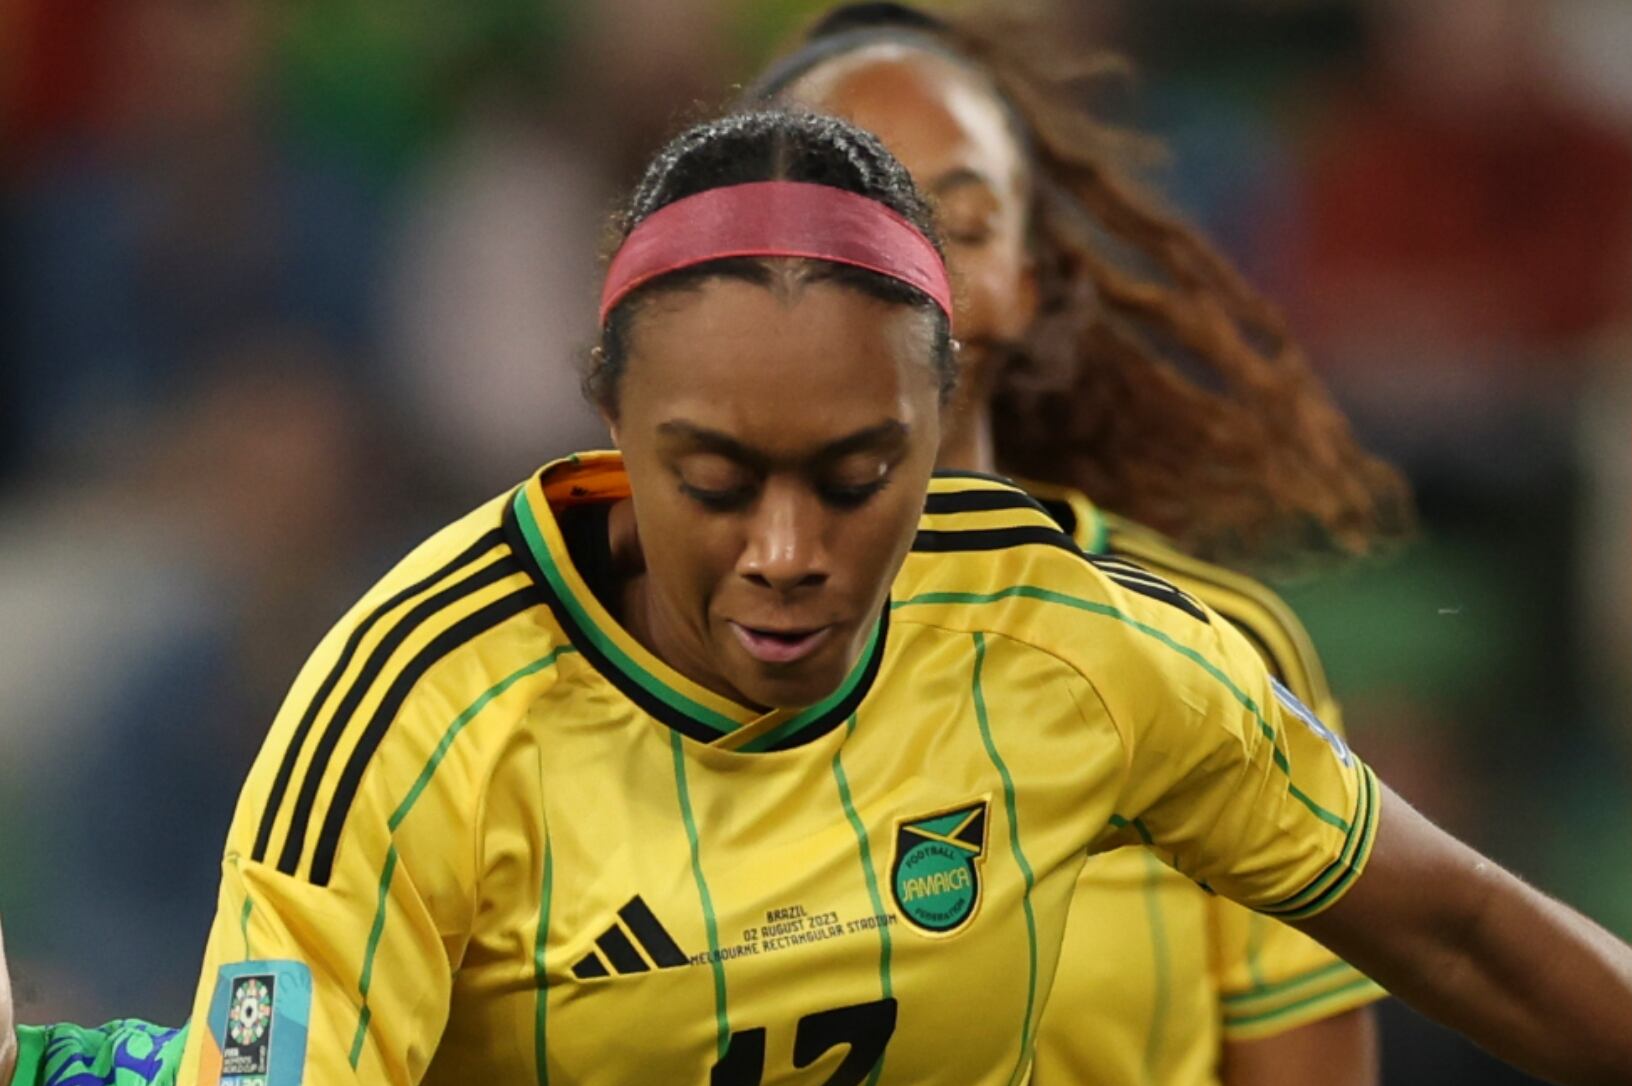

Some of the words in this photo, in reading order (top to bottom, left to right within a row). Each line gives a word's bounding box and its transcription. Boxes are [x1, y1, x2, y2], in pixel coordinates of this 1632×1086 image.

[905, 846, 956, 869] FOOTBALL
[902, 867, 970, 902] JAMAICA
[743, 928, 757, 942] 02
[761, 921, 804, 939] AUGUST
[809, 911, 839, 929] 2023
[766, 905, 807, 924] BRAZIL
[690, 943, 759, 965] MELBOURNE
[763, 925, 844, 952] RECTANGULAR
[848, 914, 897, 933] STADIUM
